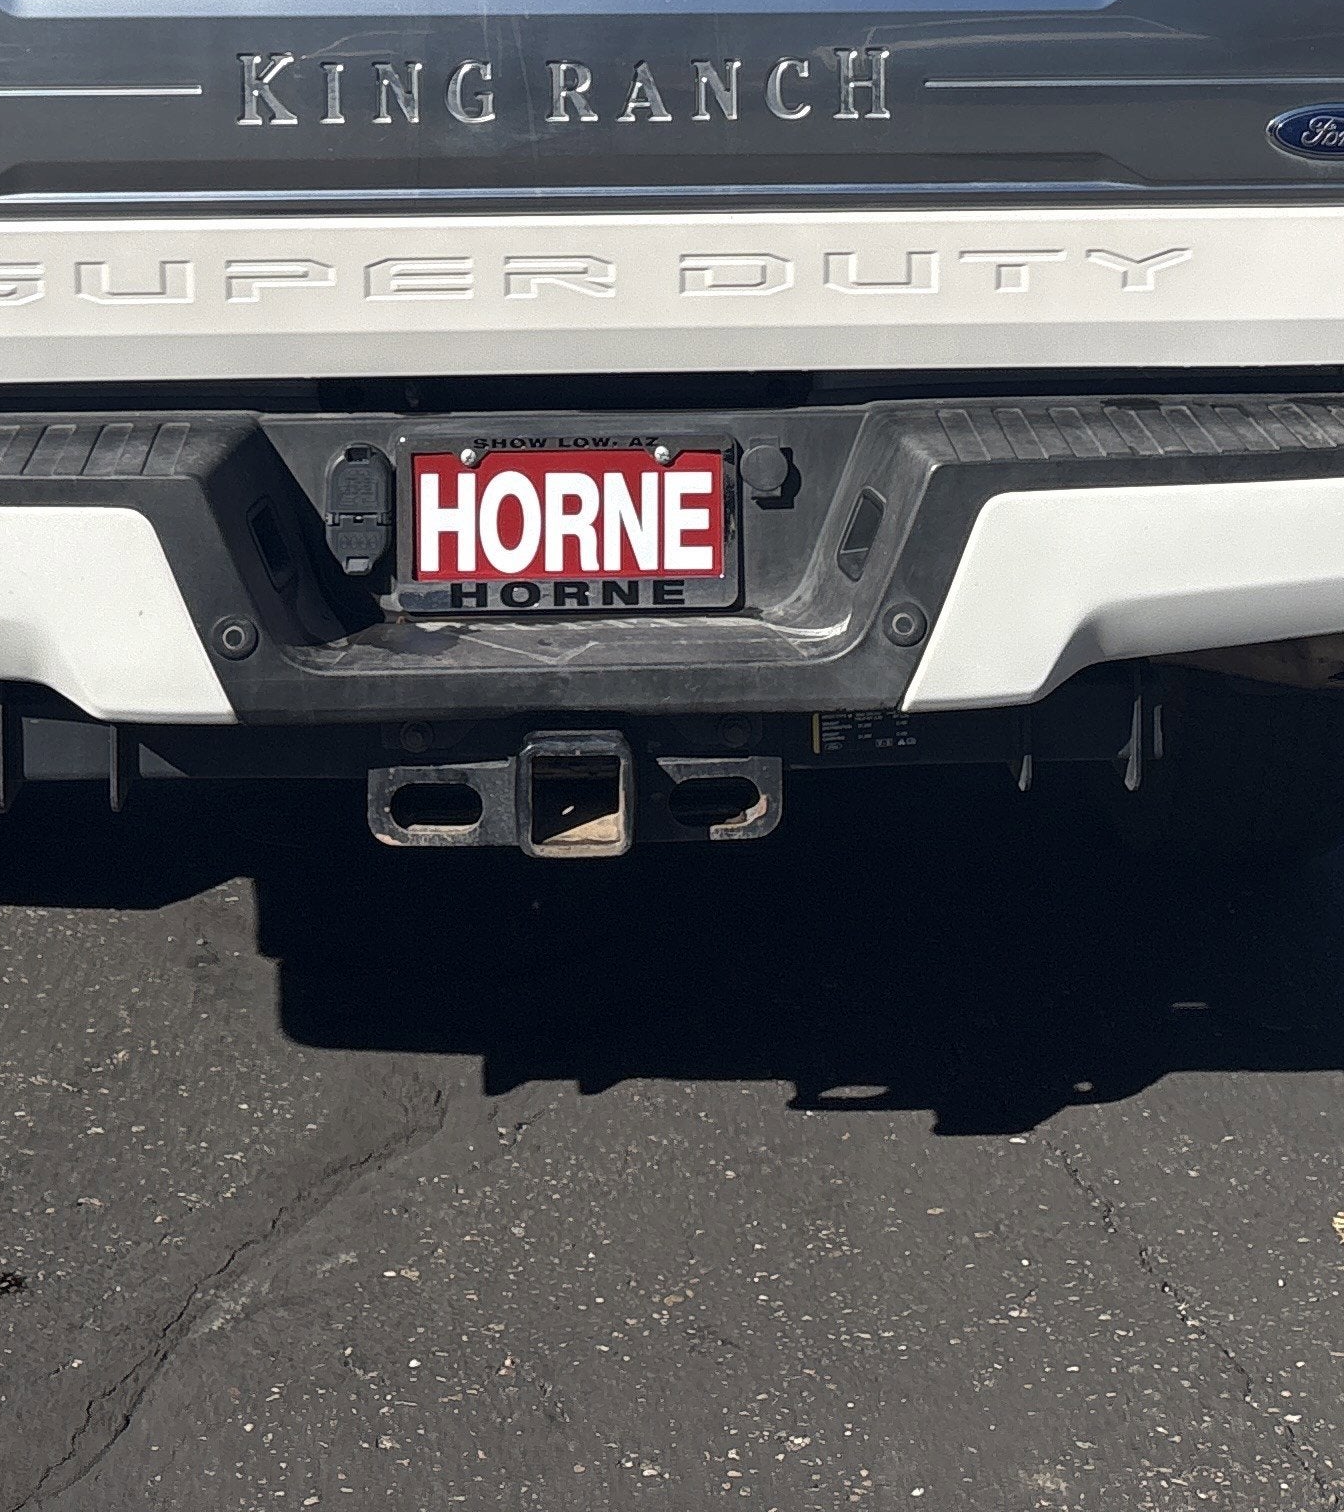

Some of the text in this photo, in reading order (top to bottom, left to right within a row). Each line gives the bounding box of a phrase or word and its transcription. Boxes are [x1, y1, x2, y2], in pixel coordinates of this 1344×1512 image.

[236, 47, 891, 126] KING RANCH
[678, 247, 1193, 298] DUTY
[473, 437, 547, 449] SHOW
[629, 435, 660, 448] AZ
[419, 470, 714, 574] HORNE
[450, 580, 686, 608] HORNE
